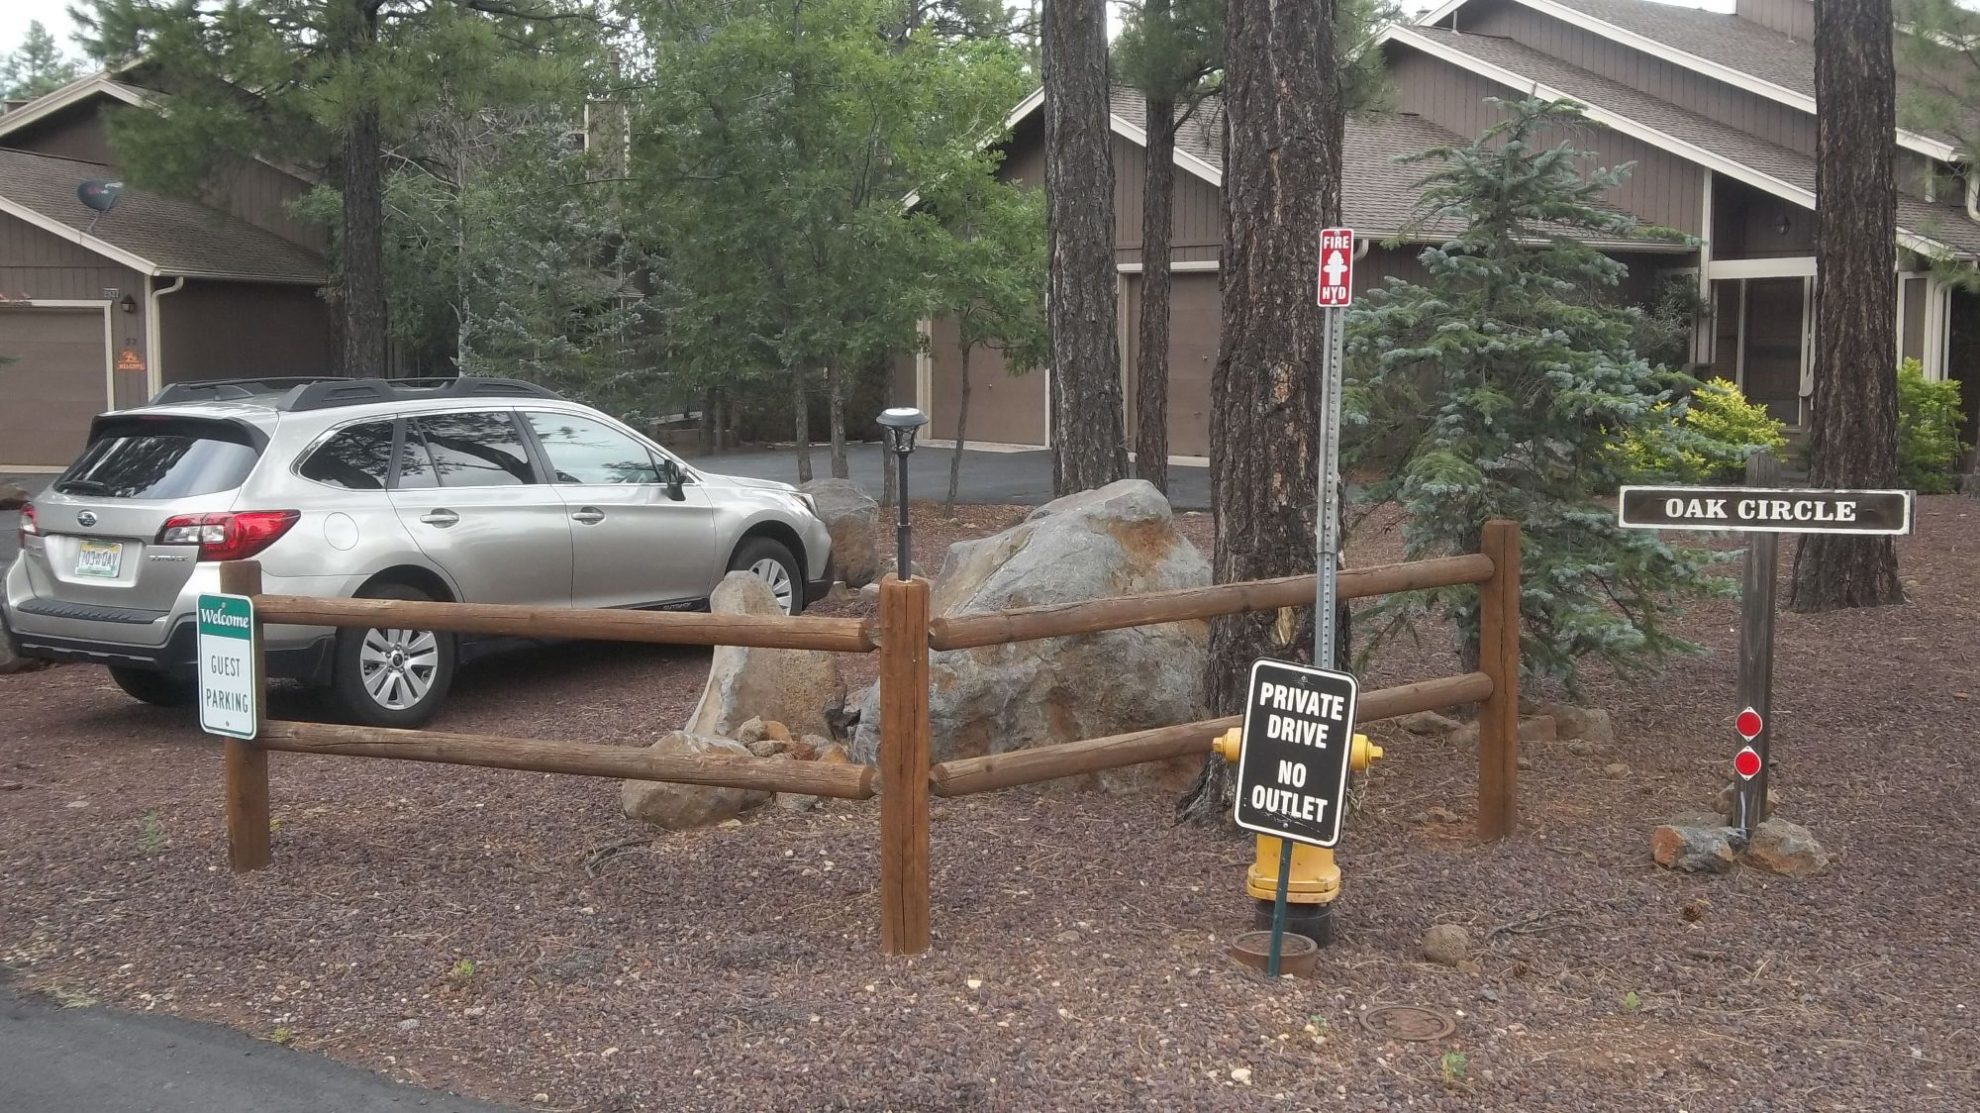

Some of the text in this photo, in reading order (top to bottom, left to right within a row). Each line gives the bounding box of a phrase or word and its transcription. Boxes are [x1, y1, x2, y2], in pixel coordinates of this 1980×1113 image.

[1323, 236, 1349, 249] FIRE
[1322, 286, 1346, 300] HYD
[1665, 498, 1857, 522] OAK CIRCLE
[200, 607, 250, 629] Welcome
[210, 655, 241, 677] GUEST
[206, 687, 249, 714] PARKING
[1259, 682, 1344, 721] PRIVATE
[1267, 714, 1329, 749] DRIVE
[1277, 759, 1307, 788] NO
[1251, 785, 1328, 823] OUTLET
